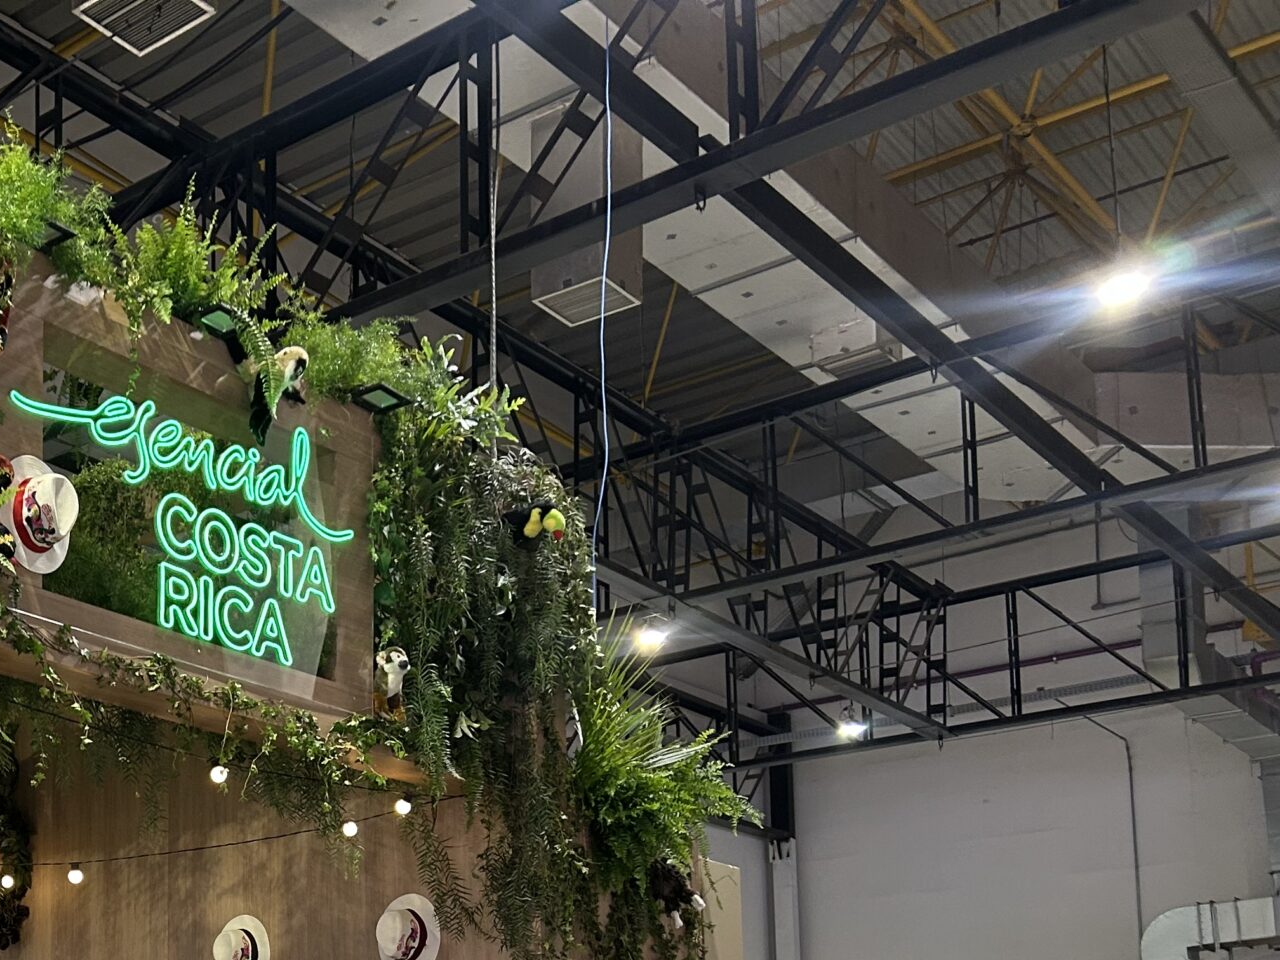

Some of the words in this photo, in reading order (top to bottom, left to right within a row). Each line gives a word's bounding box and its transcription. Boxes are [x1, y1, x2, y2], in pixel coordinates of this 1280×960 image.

[10, 390, 354, 542] esencial
[155, 492, 336, 613] COSTA
[157, 562, 293, 666] RICA
